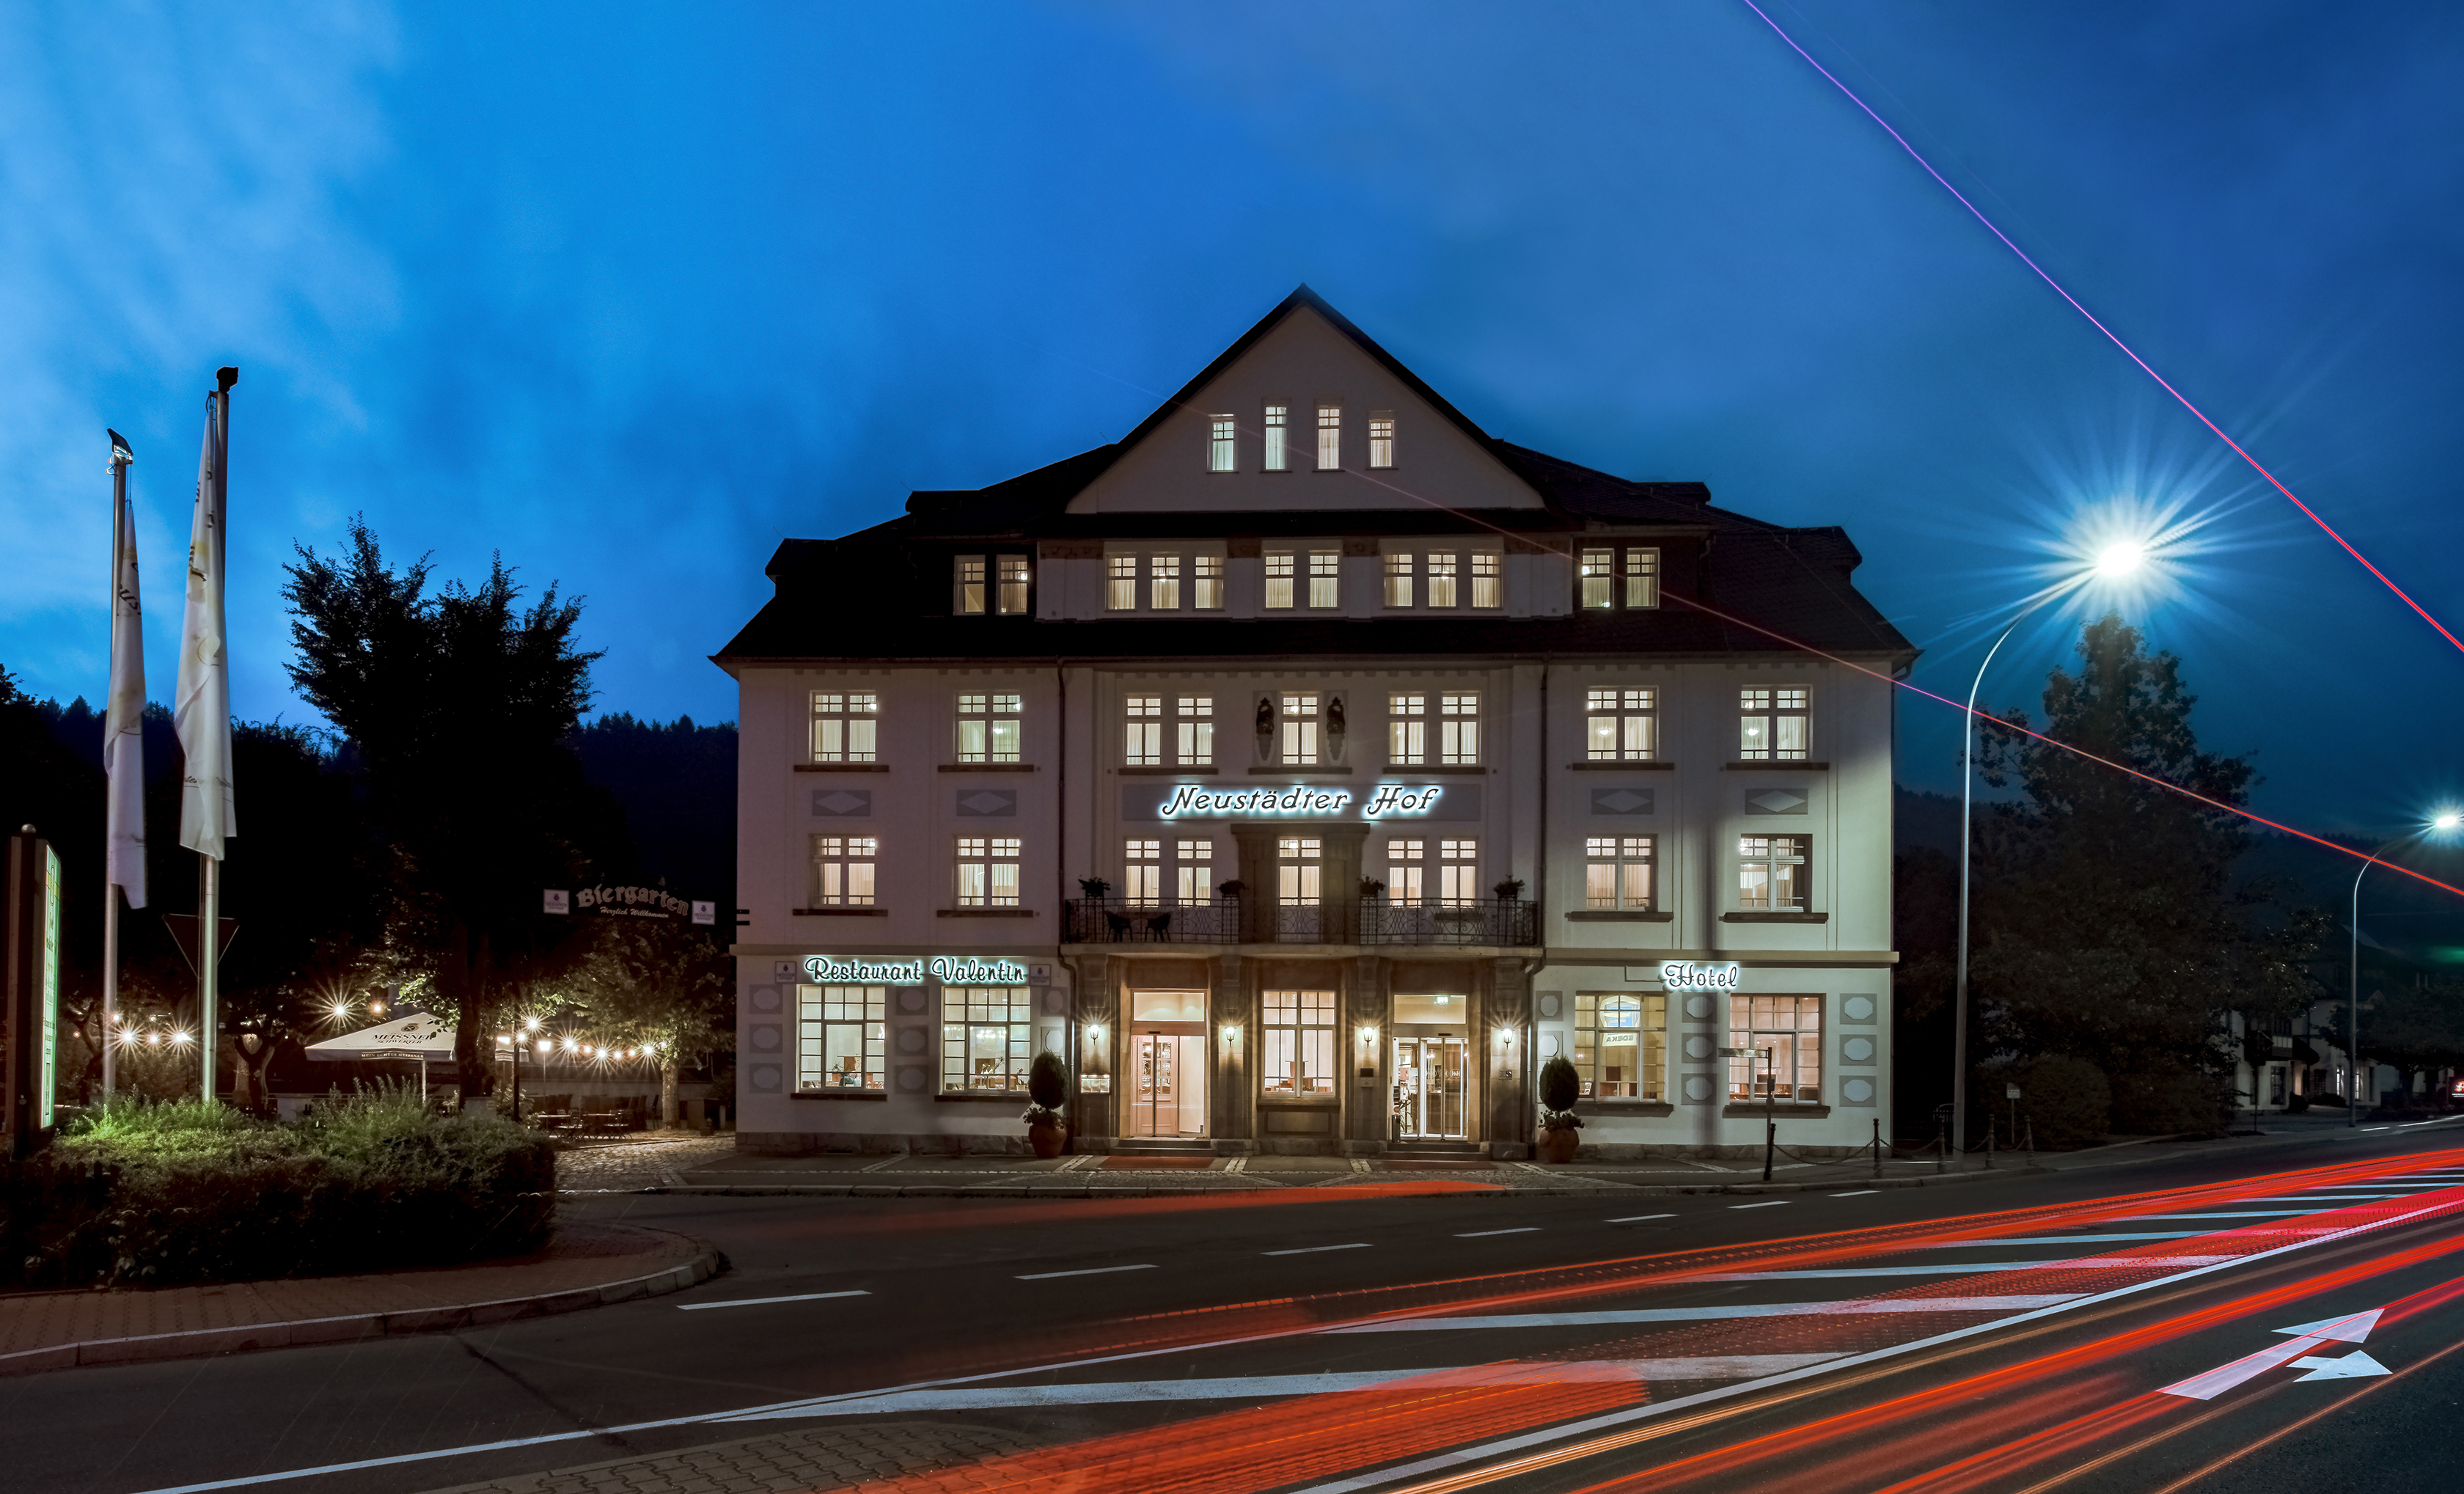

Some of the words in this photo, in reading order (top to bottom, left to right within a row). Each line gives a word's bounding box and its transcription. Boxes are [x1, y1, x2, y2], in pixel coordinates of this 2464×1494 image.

[1162, 788, 1349, 815] Neustädter
[1367, 787, 1440, 815] Hof
[576, 883, 689, 916] Biergarten
[599, 906, 628, 916] Herzlich
[630, 908, 670, 918] Willkommen
[804, 957, 922, 981] Restaurant
[931, 958, 1024, 981] Valentin
[1665, 964, 1737, 987] Hotel
